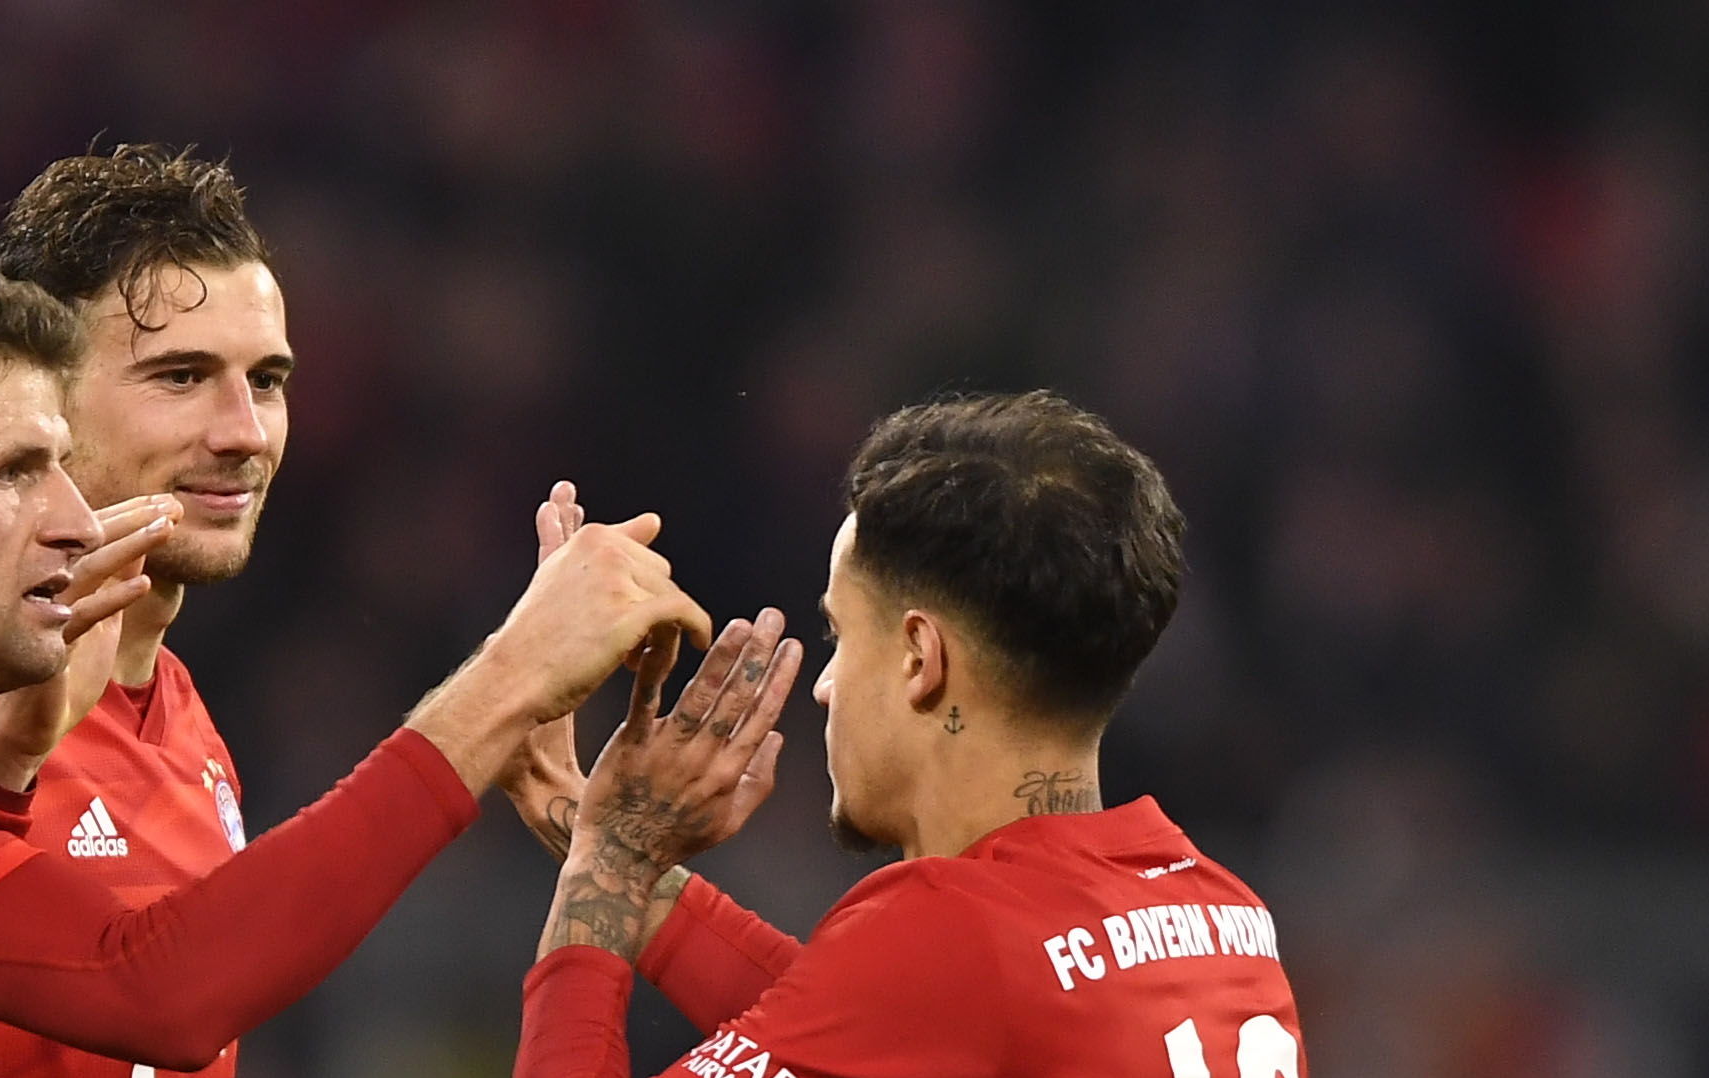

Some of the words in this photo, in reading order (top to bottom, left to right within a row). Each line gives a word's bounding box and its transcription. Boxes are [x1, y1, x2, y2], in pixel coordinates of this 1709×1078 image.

[67, 834, 129, 857] adidas
[1043, 927, 1106, 991] FC
[1102, 903, 1216, 970] BAYERN
